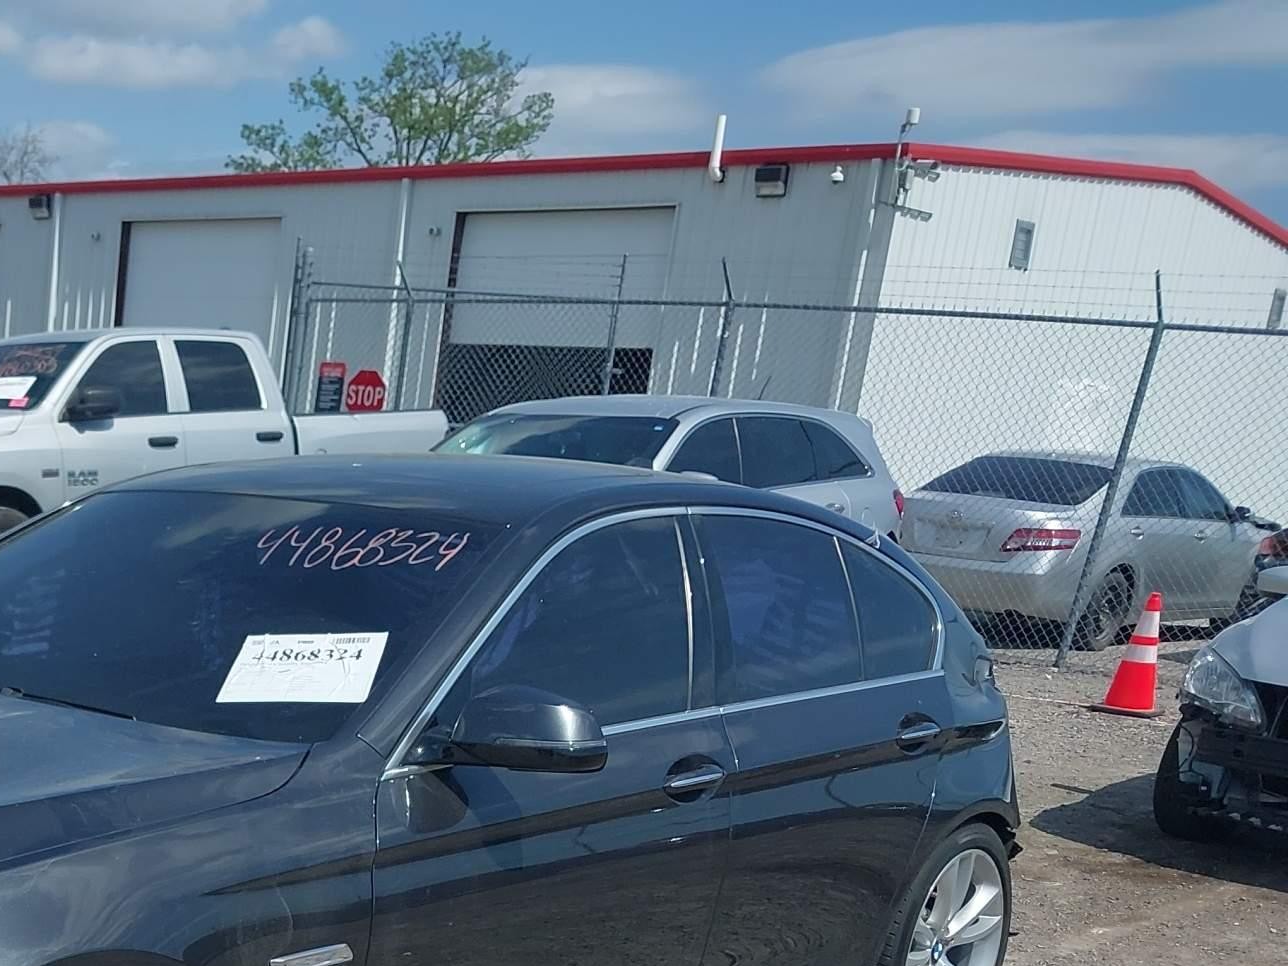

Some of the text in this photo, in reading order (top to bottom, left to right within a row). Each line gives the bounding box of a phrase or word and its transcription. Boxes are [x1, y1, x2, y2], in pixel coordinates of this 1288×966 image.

[346, 384, 385, 407] STOP
[257, 524, 471, 571] 44868324
[252, 648, 363, 662] 44868324
